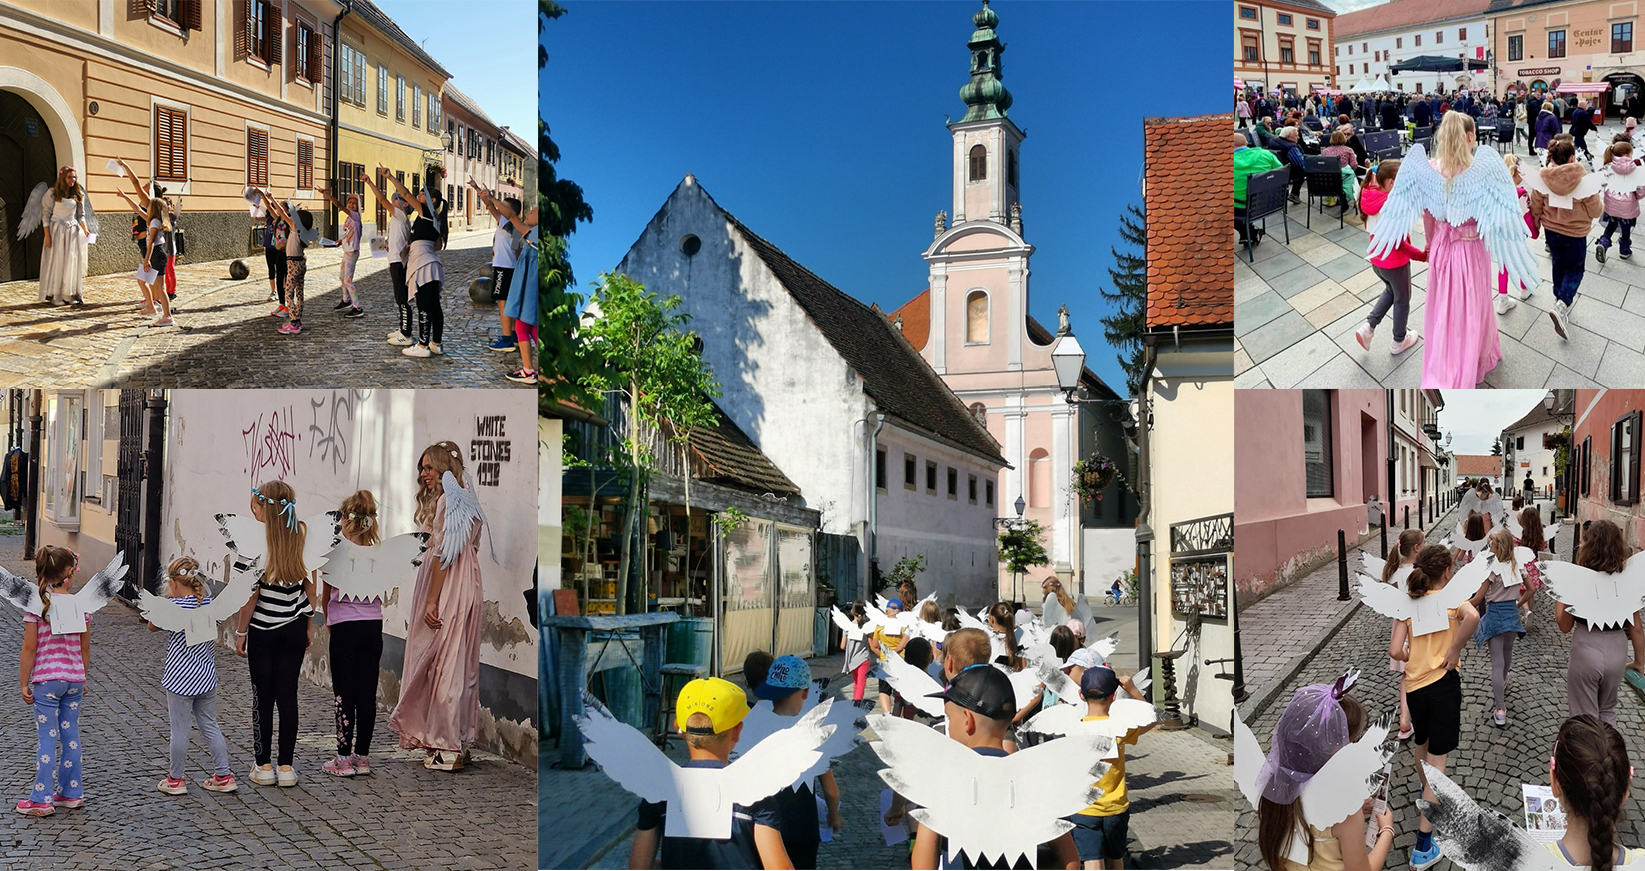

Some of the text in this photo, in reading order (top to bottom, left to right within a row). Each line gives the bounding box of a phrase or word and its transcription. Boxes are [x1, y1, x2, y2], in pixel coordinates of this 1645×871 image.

[476, 415, 506, 437] WHITE
[470, 439, 511, 462] STONES
[686, 701, 715, 711] MINIONS
